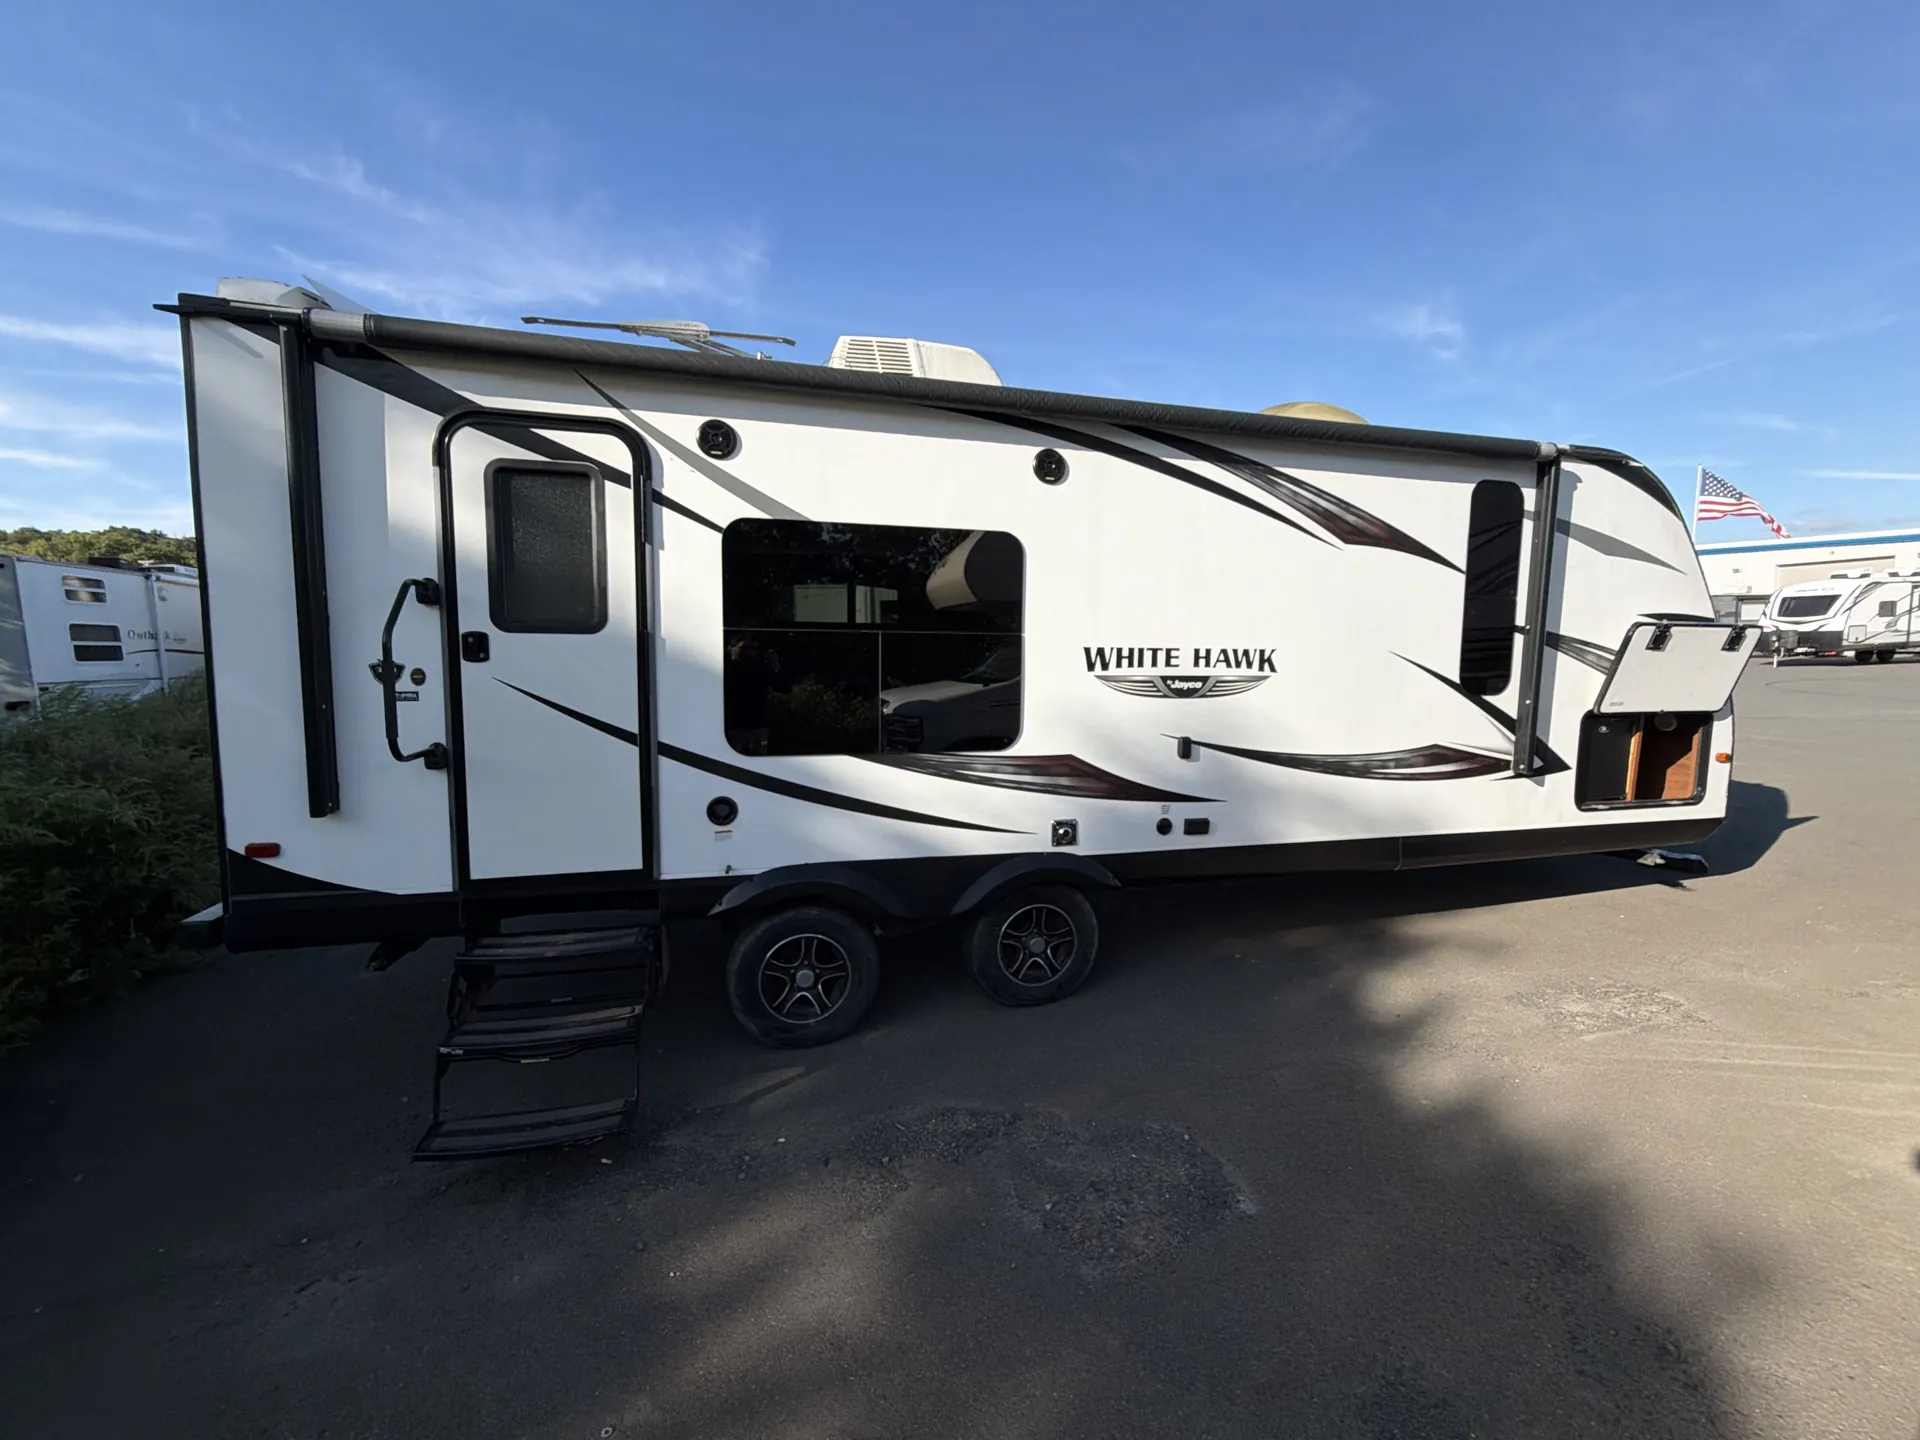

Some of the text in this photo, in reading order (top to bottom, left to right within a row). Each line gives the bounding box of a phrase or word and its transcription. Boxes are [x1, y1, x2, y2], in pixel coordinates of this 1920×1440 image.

[127, 629, 171, 641] Outbk
[1083, 646, 1278, 673] WHITE HAWK
[1170, 679, 1203, 690] Jayco
